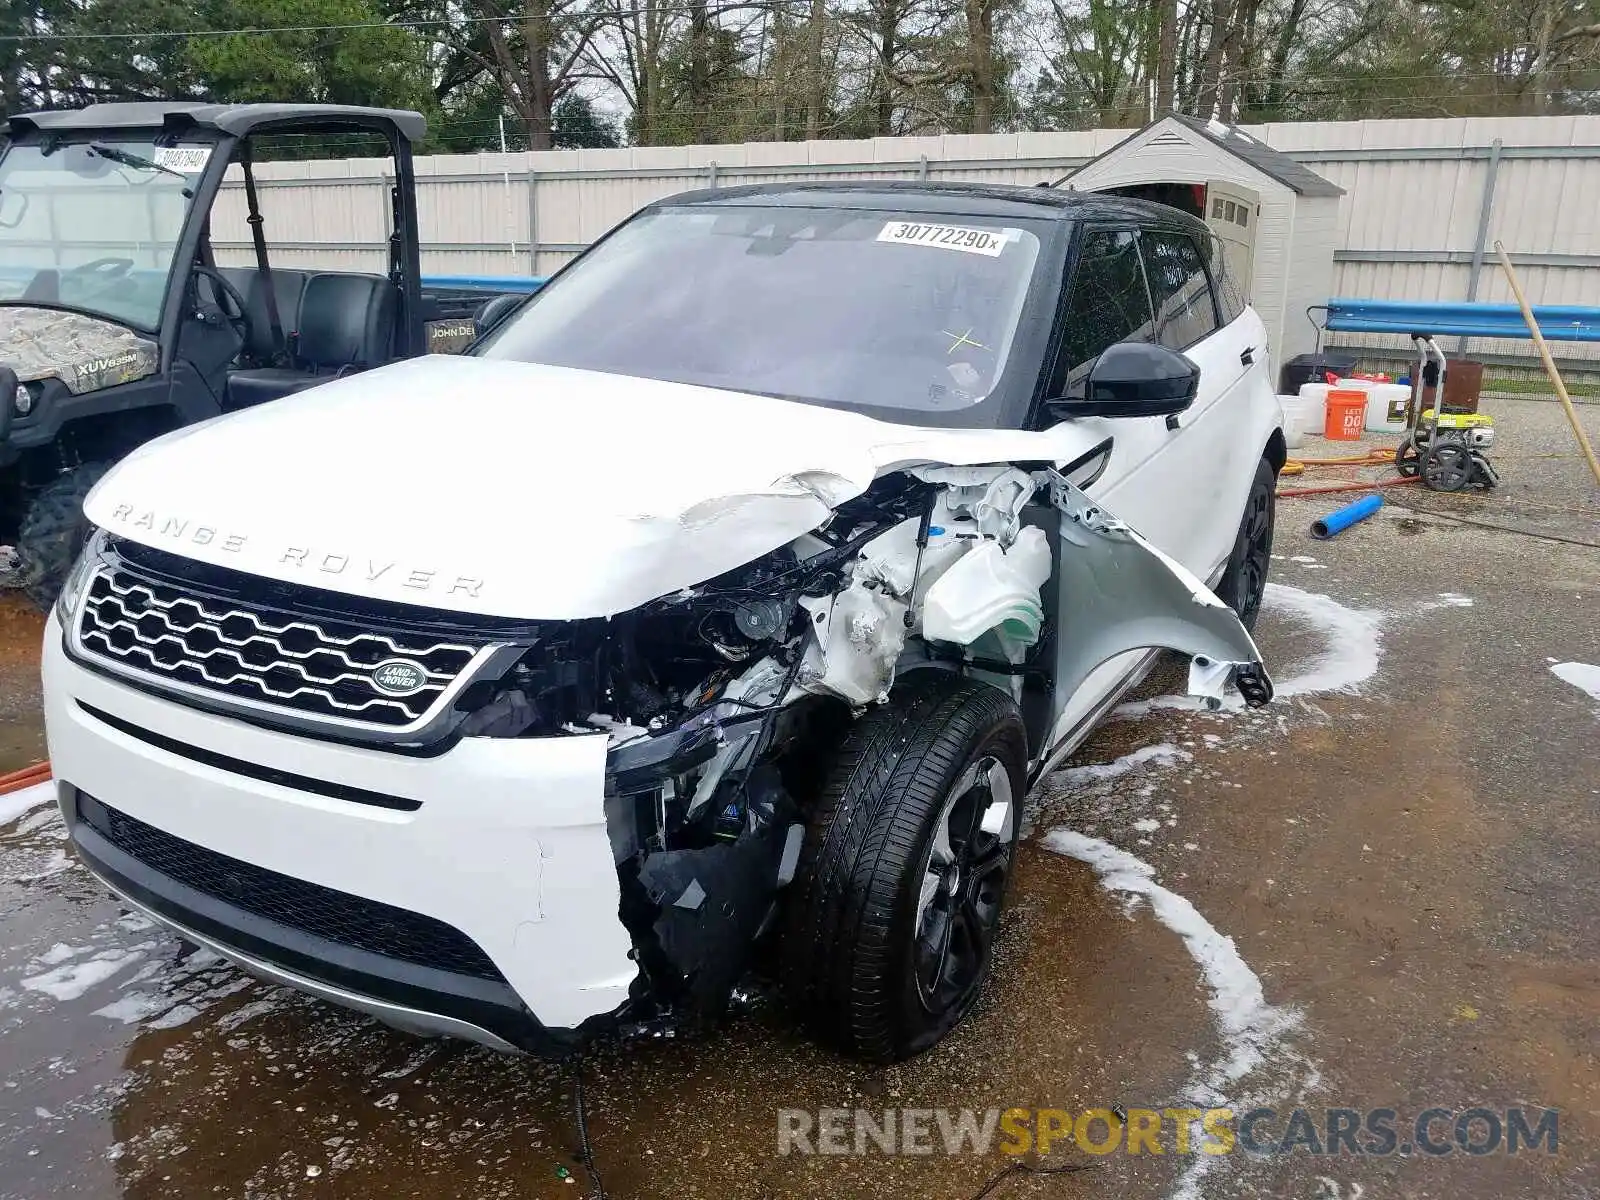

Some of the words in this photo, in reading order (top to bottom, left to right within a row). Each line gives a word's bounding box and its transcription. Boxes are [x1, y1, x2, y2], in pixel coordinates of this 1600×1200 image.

[432, 327, 458, 338] JOHN
[78, 353, 137, 377] XUV835M
[112, 503, 248, 553] RANGE
[278, 547, 485, 598] ROVER
[384, 666, 411, 677] LAND
[383, 675, 417, 688] ROVER
